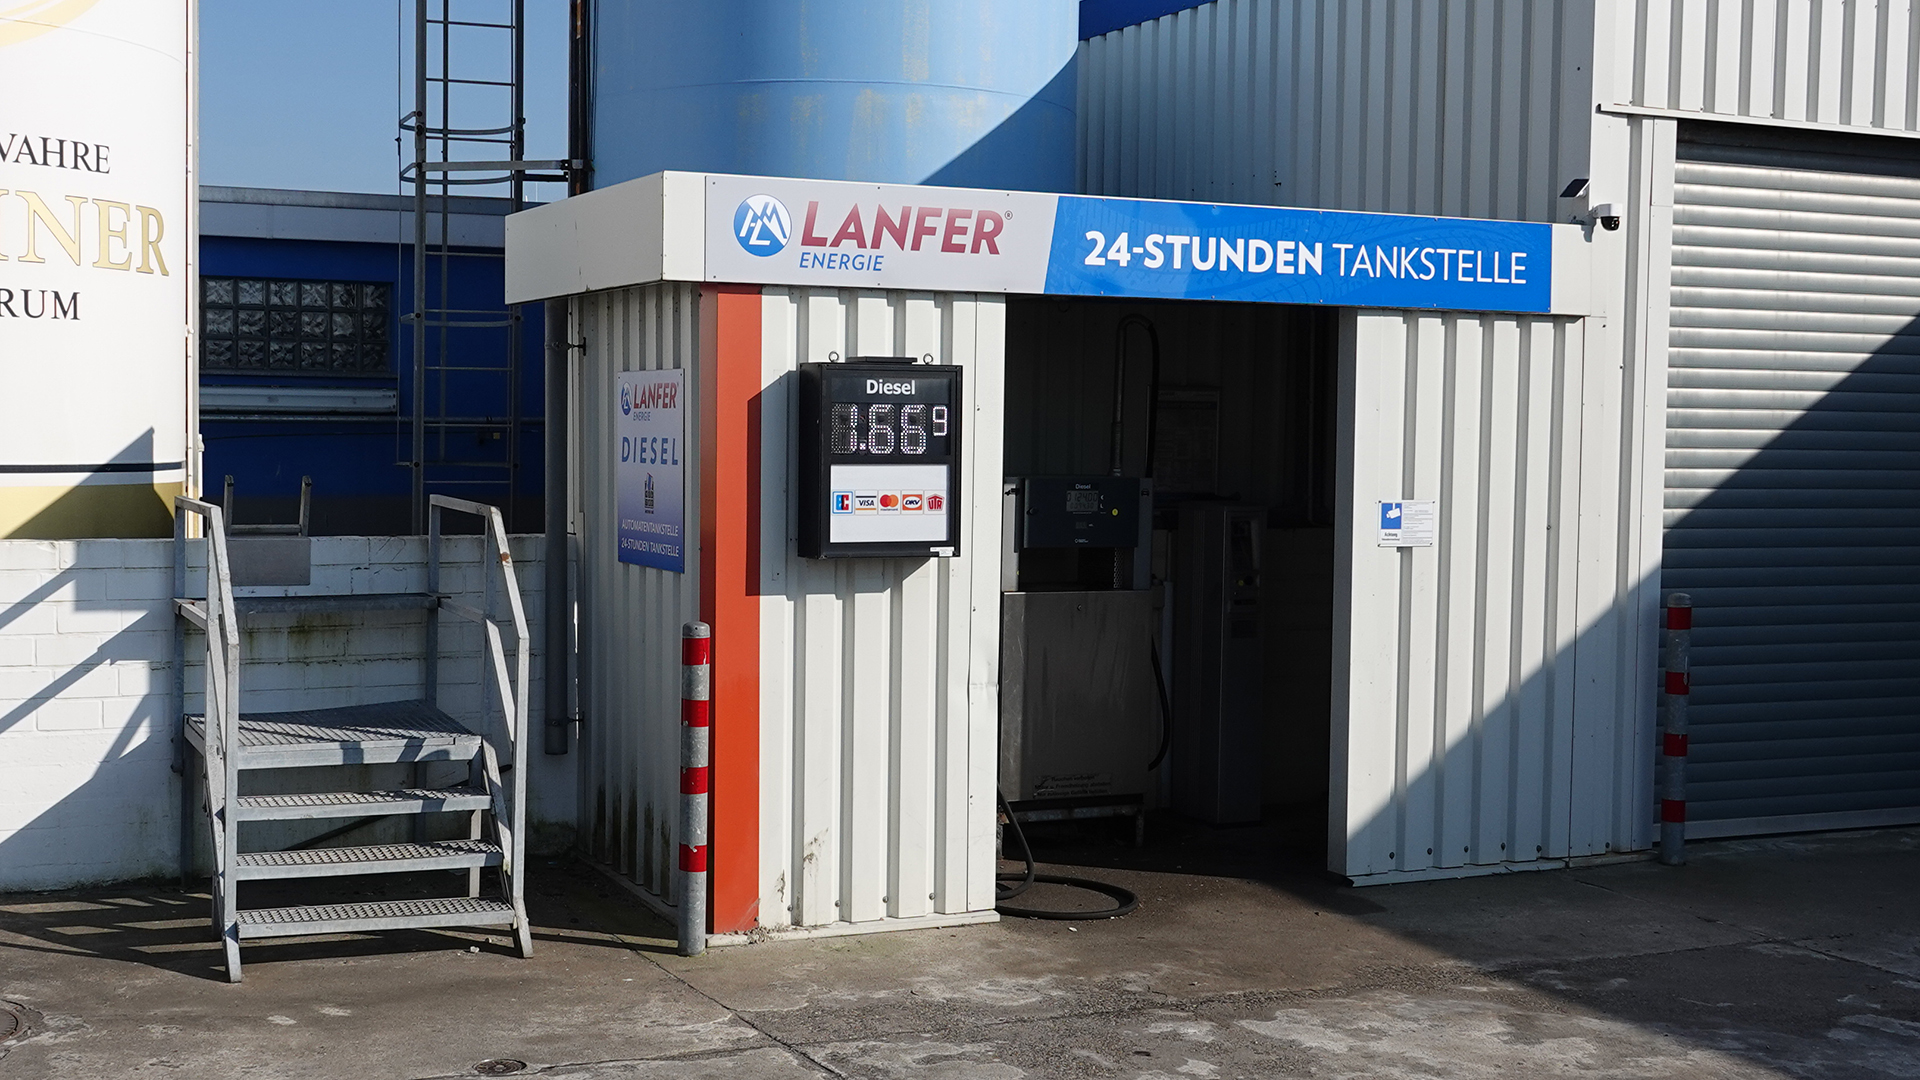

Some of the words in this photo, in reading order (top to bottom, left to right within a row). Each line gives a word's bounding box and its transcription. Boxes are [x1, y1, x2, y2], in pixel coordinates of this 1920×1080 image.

[0, 189, 170, 276] NER
[799, 252, 885, 272] ENERGIE
[1084, 230, 1322, 276] 24-STUNDEN
[1332, 242, 1527, 284] TANKSTELLE
[633, 382, 678, 409] LANFER
[866, 379, 916, 395] Diesel
[621, 437, 679, 465] DIESEL
[858, 499, 875, 507] VISA
[649, 541, 679, 557] TANKSTELLE
